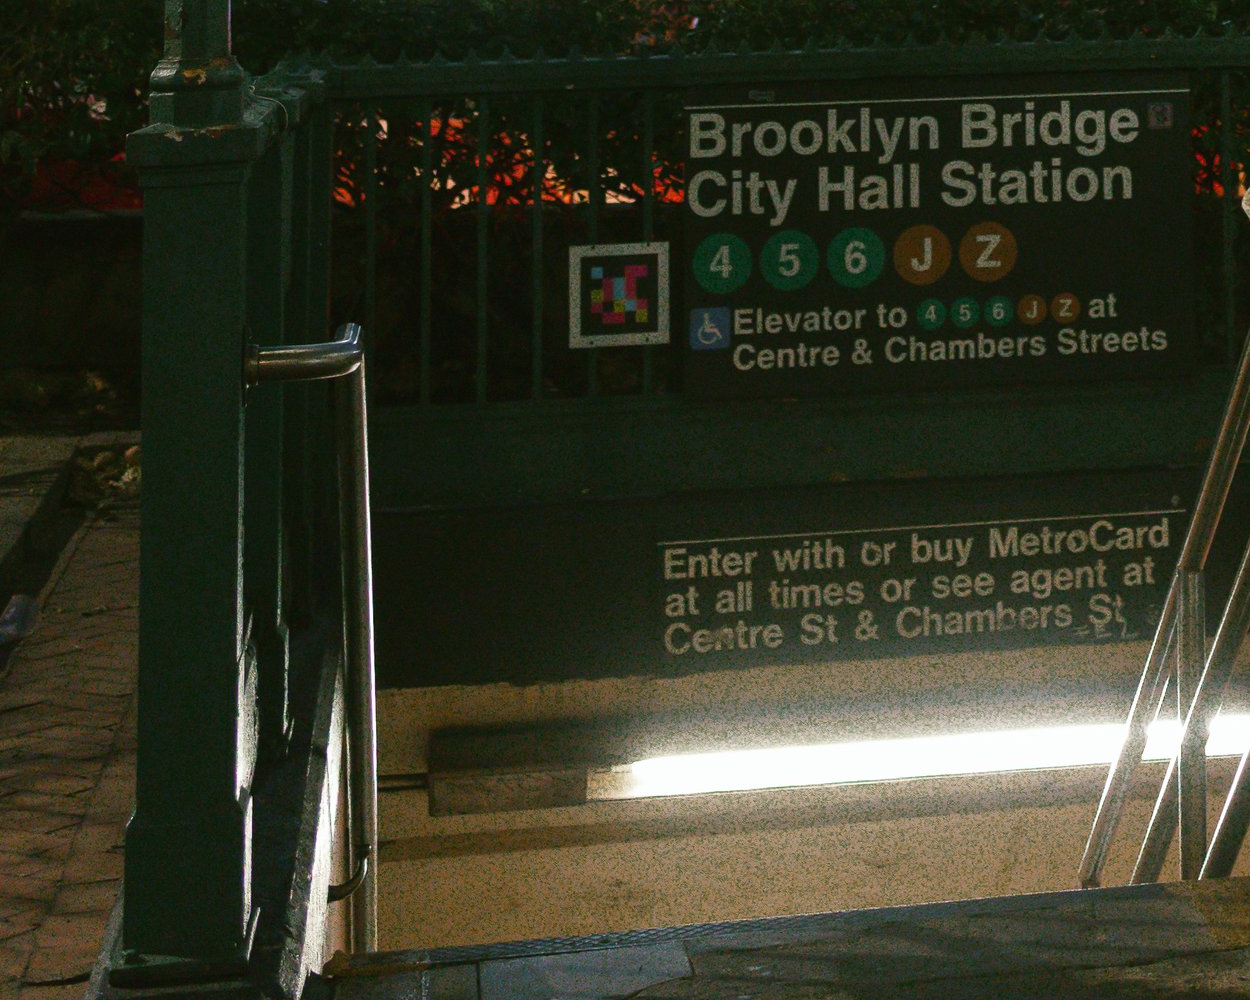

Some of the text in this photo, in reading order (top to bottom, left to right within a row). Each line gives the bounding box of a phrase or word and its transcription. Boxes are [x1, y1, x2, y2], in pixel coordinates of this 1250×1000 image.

[689, 101, 1140, 164] Brooklyn Bridge
[688, 158, 1133, 226] City Hall Station
[709, 235, 1002, 278] 4 5 6 J Z
[734, 294, 1117, 336] Elevator to 4 5 6 J Z at
[733, 326, 1167, 372] Centre & Chambers Streets
[664, 518, 1169, 581] Enter with or buy MetroCard
[665, 555, 1155, 618] at all times or see agent at
[664, 621, 783, 656] Centre
[801, 611, 838, 646] St
[854, 610, 880, 641] &
[896, 601, 1073, 639] Chambers
